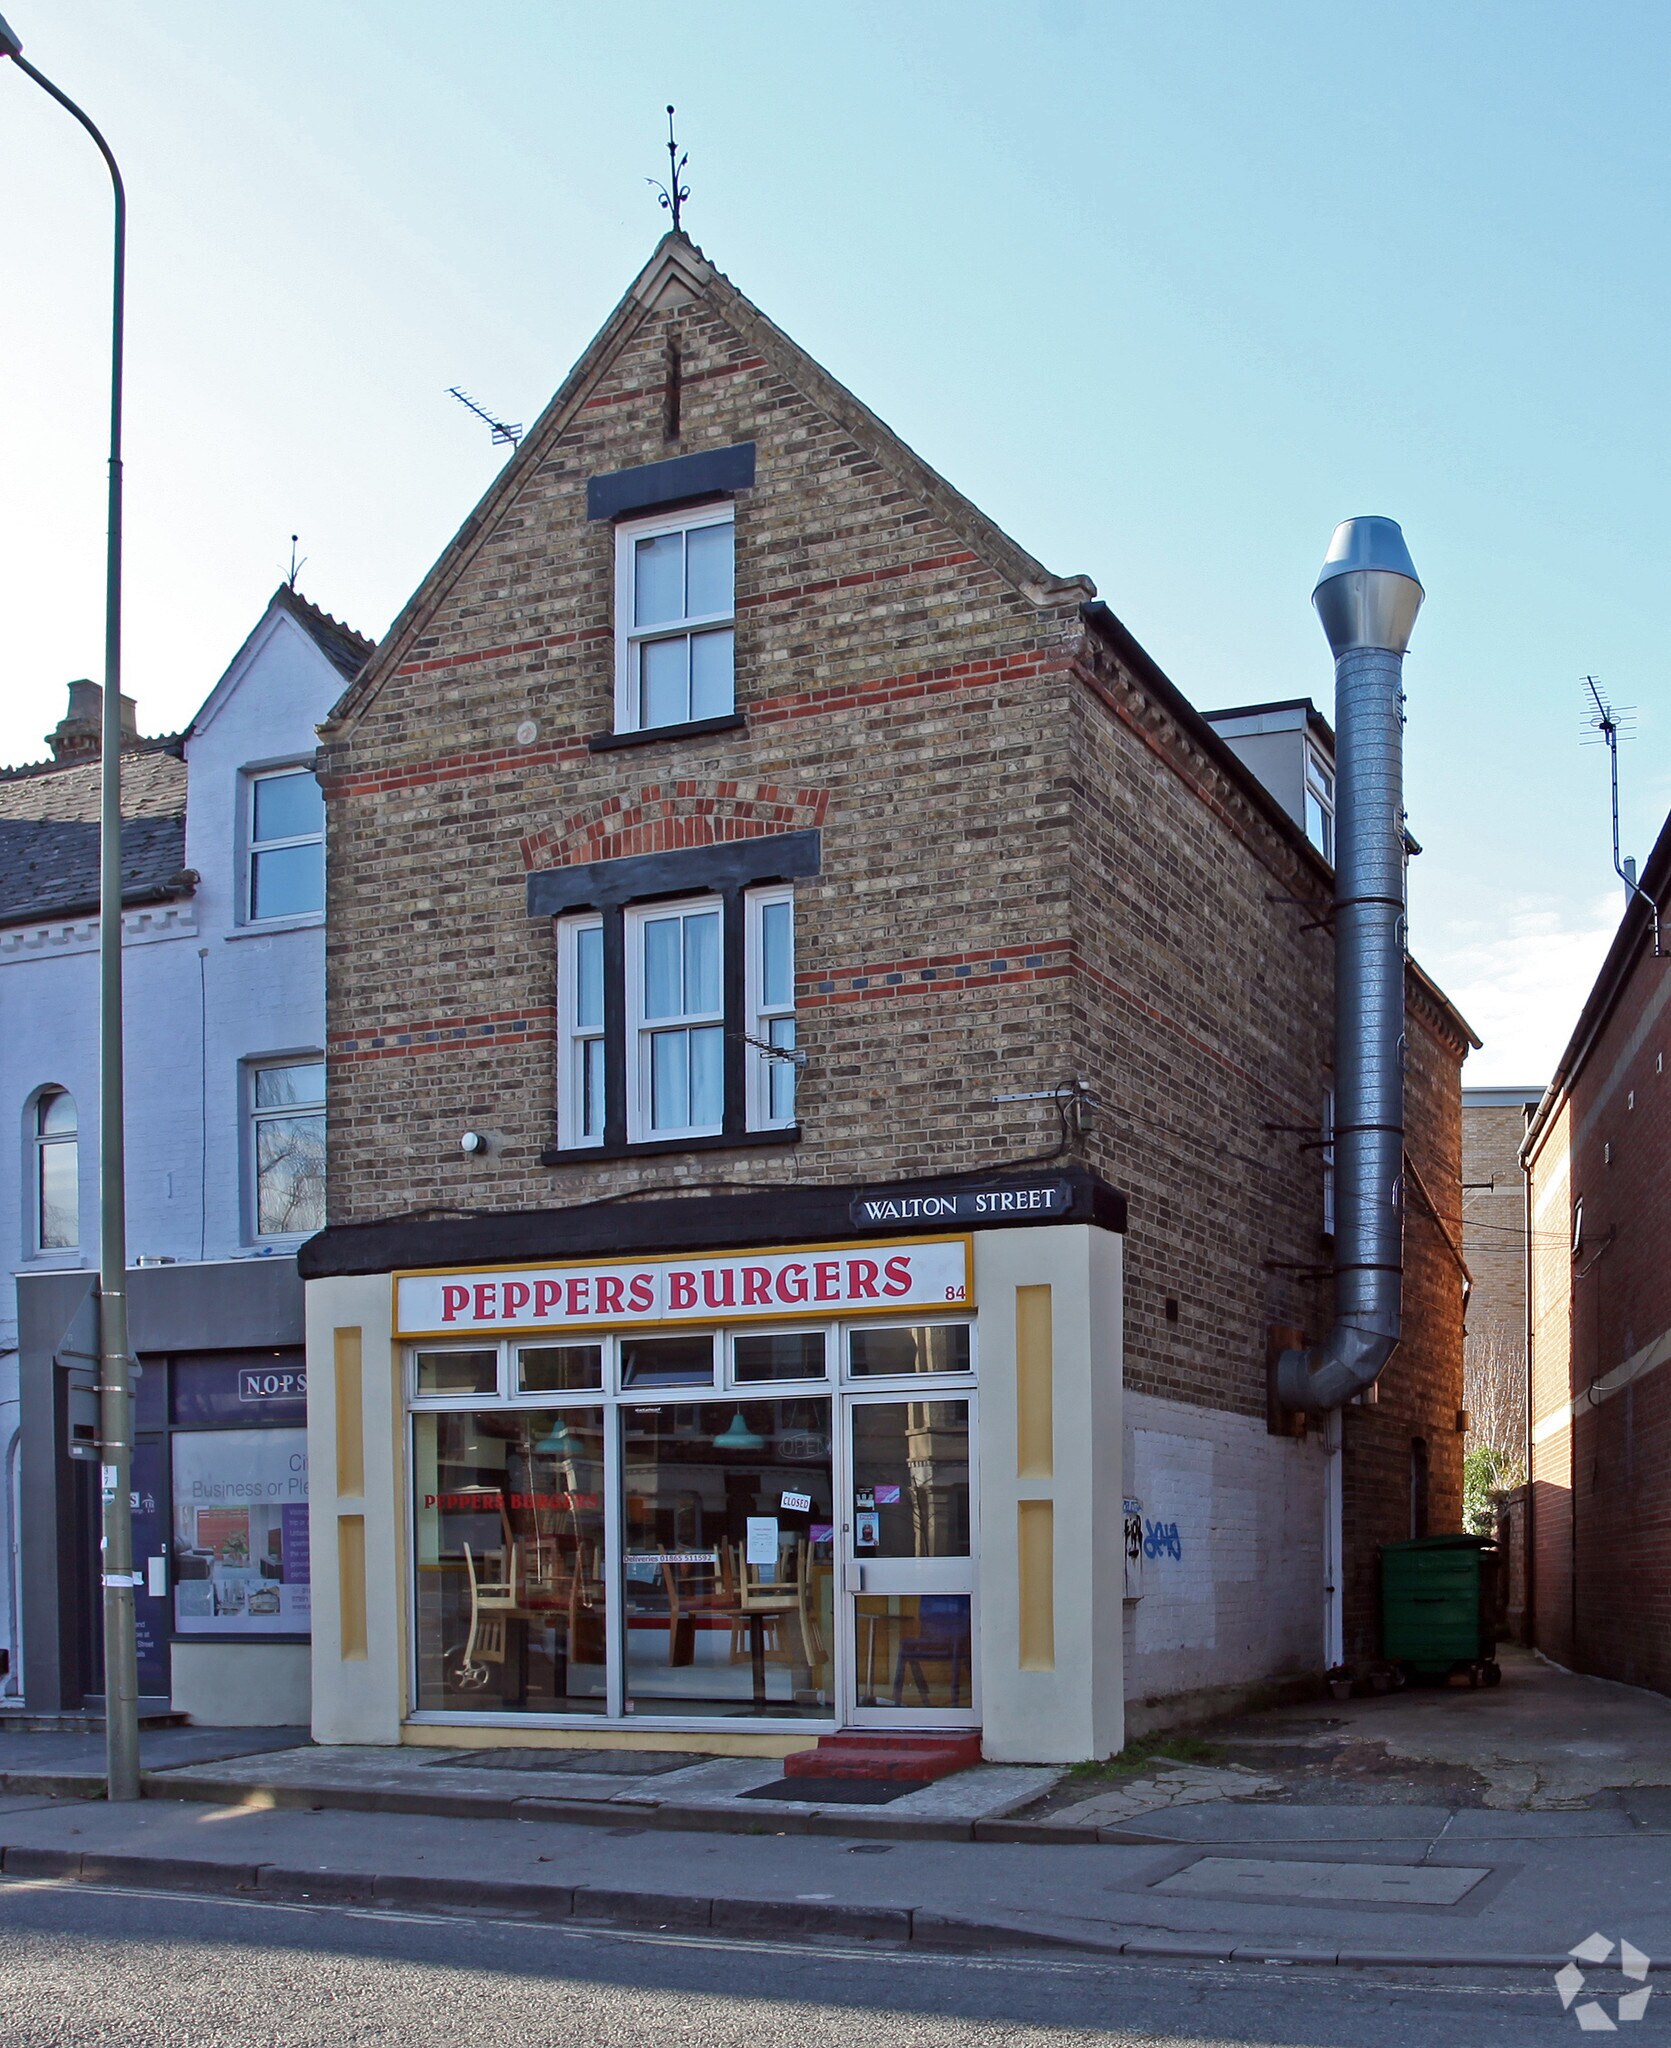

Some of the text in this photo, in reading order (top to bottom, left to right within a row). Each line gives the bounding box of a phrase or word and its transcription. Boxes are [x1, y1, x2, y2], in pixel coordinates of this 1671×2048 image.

[864, 1189, 1056, 1220] WALTON STREET
[441, 1255, 913, 1322] PEPPERS BURGERS
[944, 1285, 966, 1302] 84
[246, 1373, 307, 1395] NOPS
[192, 1480, 263, 1498] Business
[267, 1482, 284, 1496] or
[424, 1493, 506, 1509] PEPPERS
[782, 1496, 809, 1510] CLOSED
[623, 1554, 659, 1563] Deliveries
